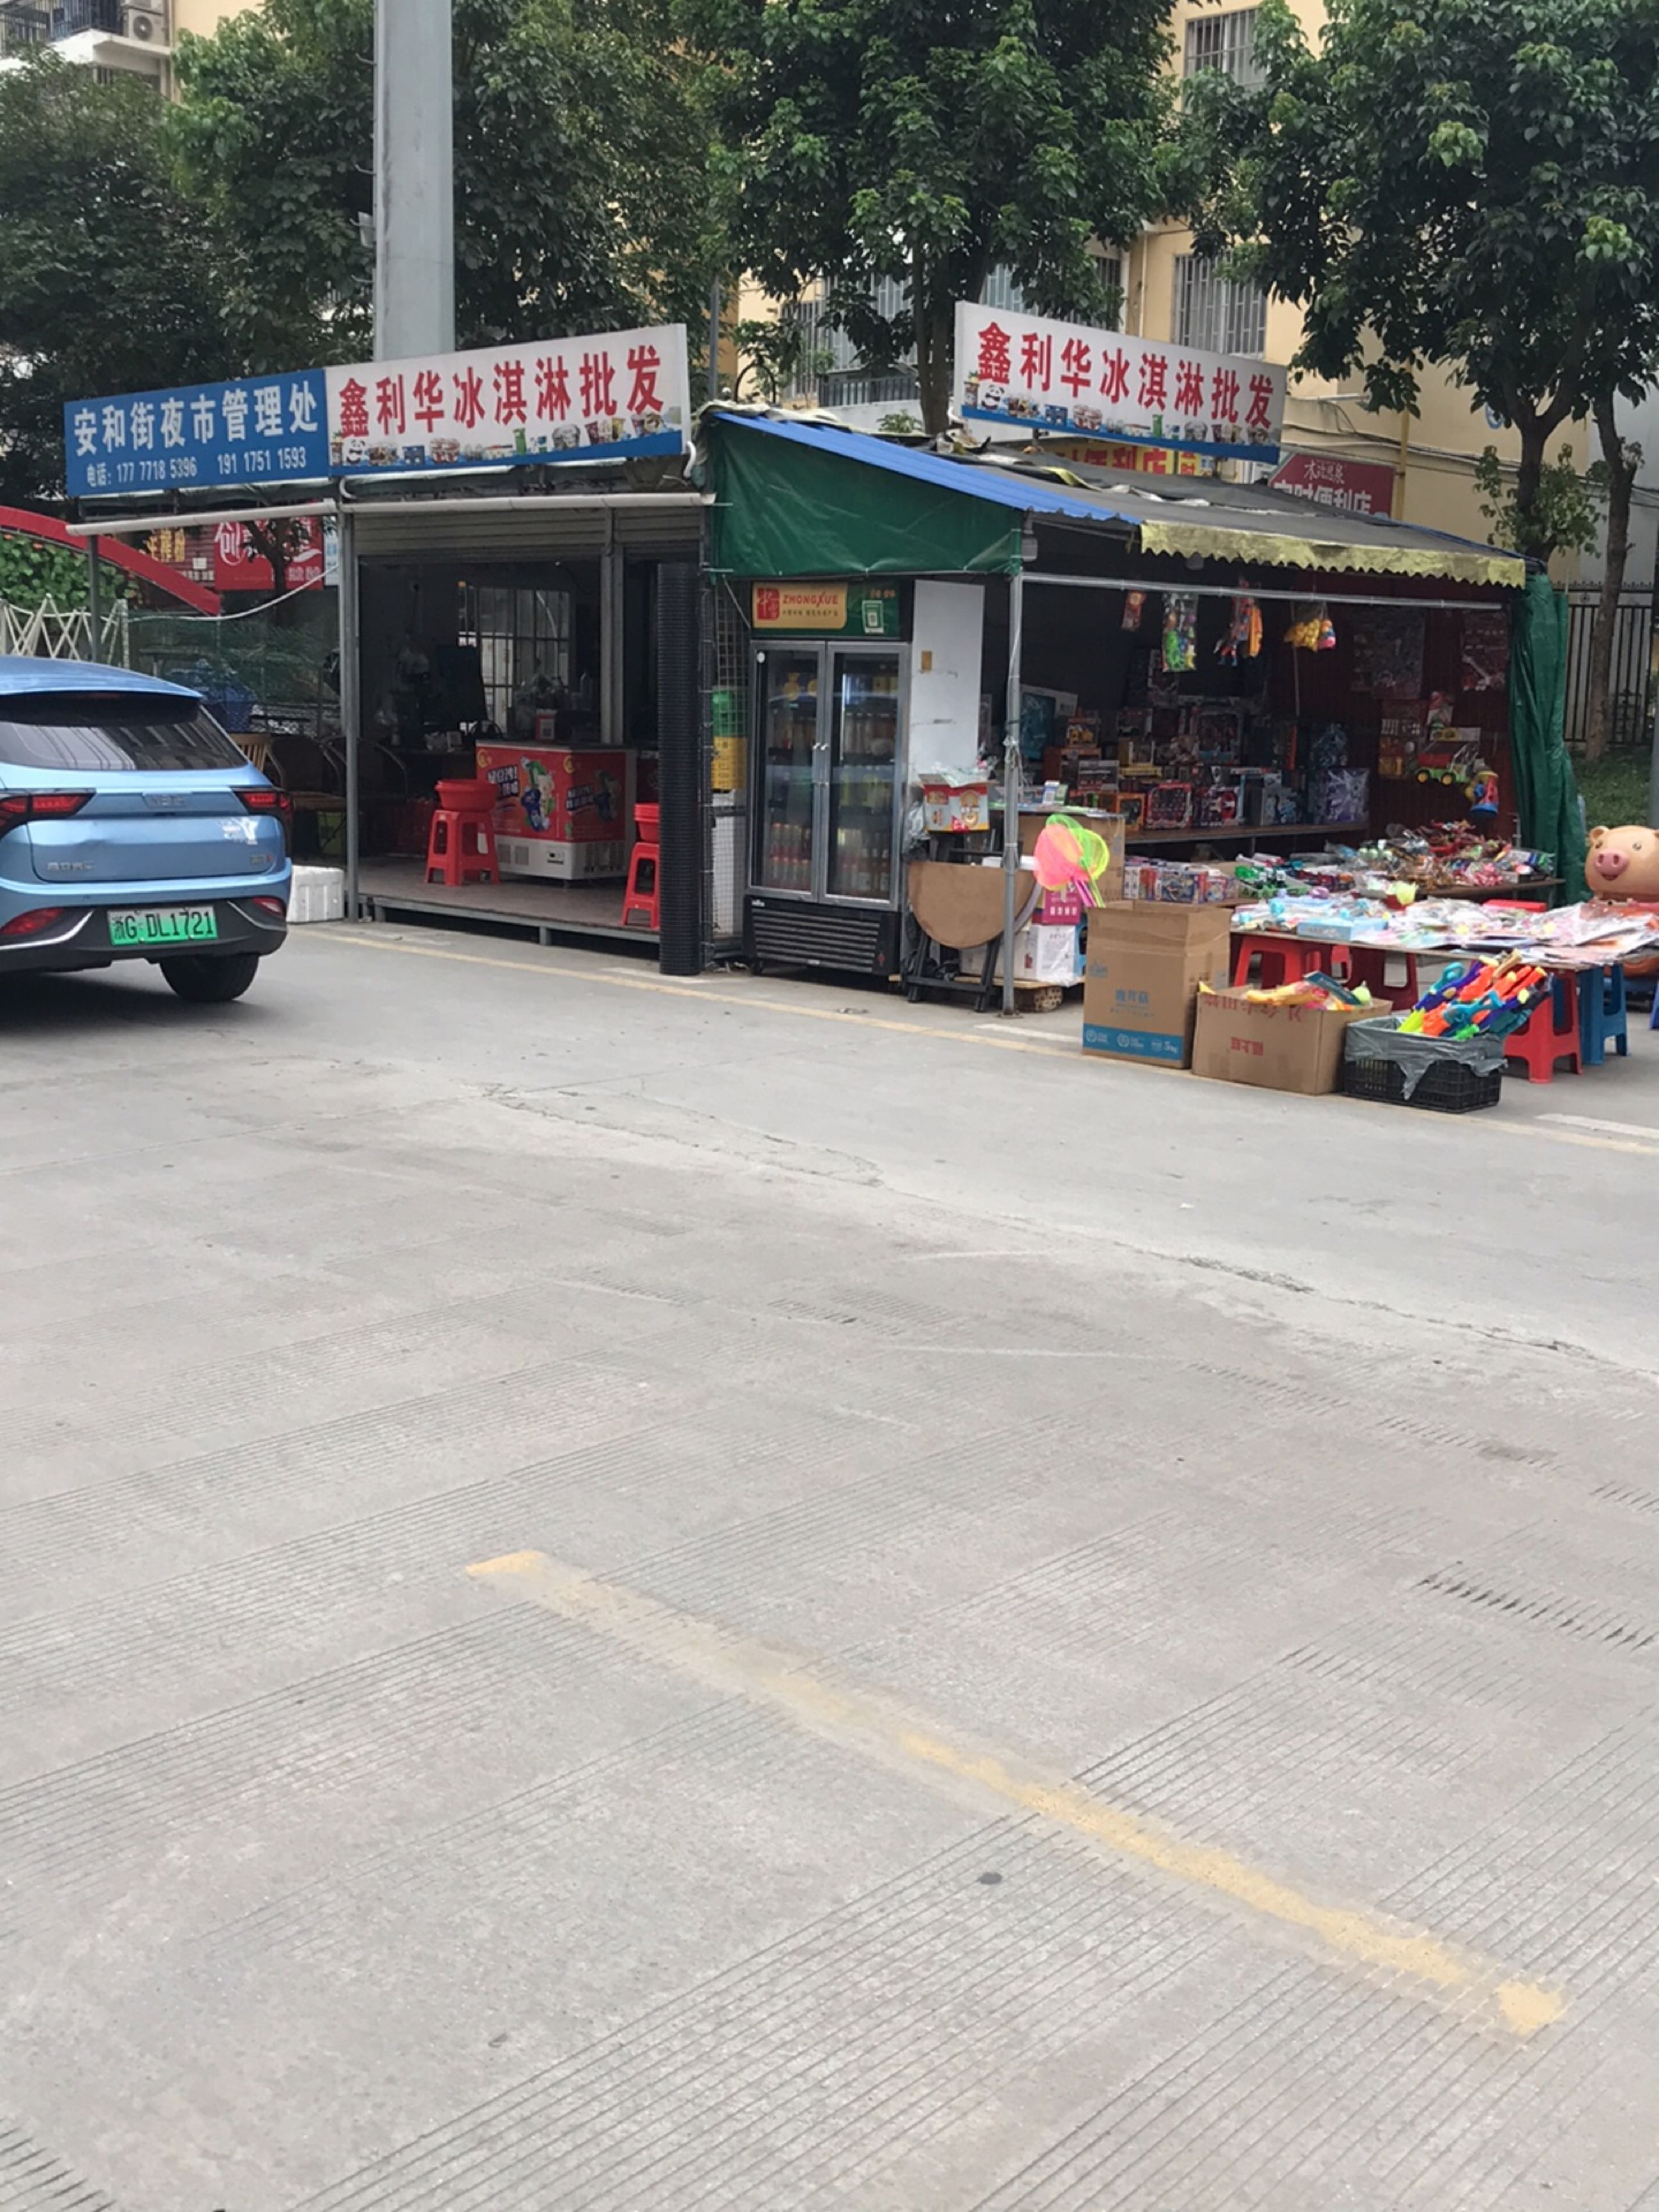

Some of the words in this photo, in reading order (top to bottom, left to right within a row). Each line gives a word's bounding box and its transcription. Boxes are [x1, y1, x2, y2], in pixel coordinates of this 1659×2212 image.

[339, 345, 664, 438] 鑫利华冰淇淋批发
[977, 322, 1274, 429] 鑫利华冰淇淋批发
[74, 380, 318, 456] 安和街夜市管理处
[116, 461, 134, 483] 177
[139, 460, 166, 481] 7718
[170, 456, 198, 479] 5396
[217, 453, 237, 475] 191
[244, 449, 271, 472] 1751
[277, 446, 307, 469] 1593
[783, 591, 839, 607] ZHONGXUE
